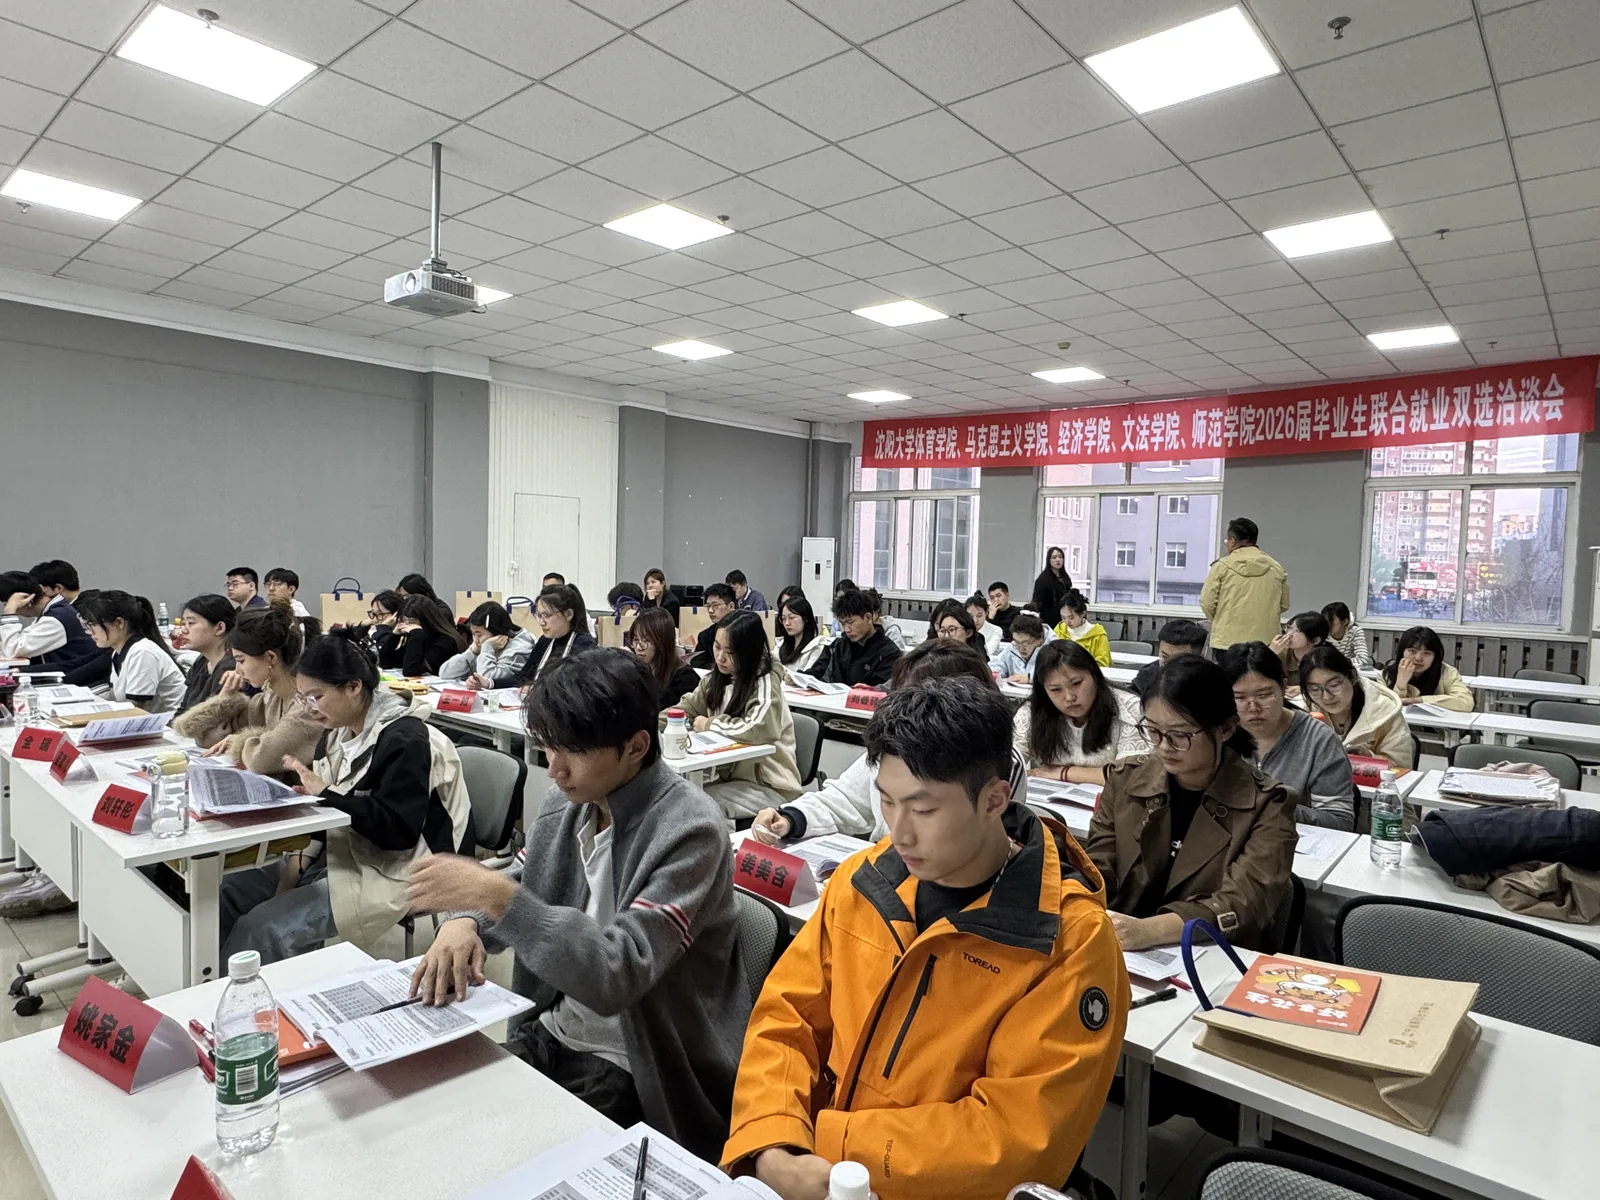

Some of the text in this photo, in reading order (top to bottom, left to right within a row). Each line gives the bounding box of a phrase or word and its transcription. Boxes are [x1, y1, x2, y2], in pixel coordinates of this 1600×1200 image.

[740, 852, 789, 889] 姜美含
[962, 951, 1001, 975] TOREAD
[75, 1000, 137, 1066] 姚家金
